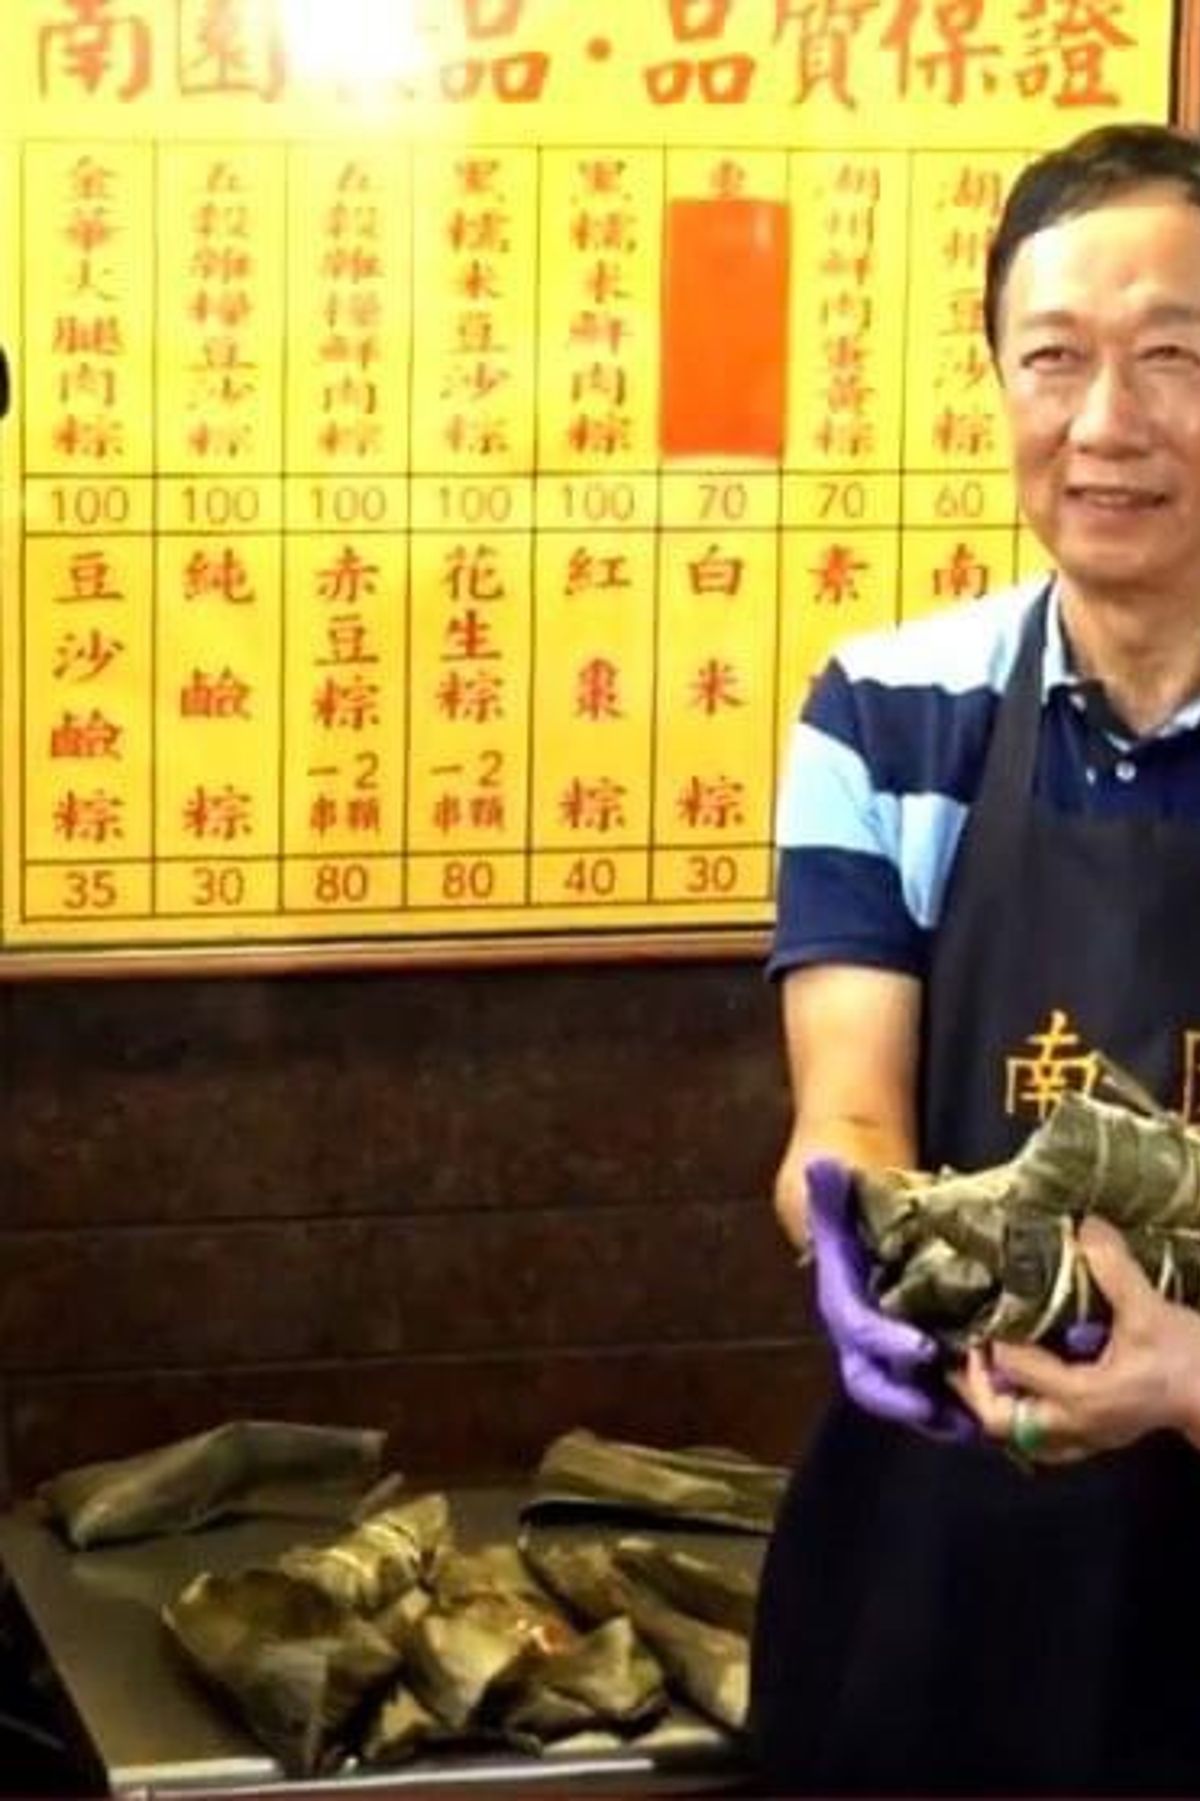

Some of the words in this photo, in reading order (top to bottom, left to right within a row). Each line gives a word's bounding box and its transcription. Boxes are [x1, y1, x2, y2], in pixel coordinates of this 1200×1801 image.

[51, 487, 129, 525] 100
[183, 486, 260, 524] 100
[309, 486, 387, 523] 100
[437, 485, 512, 522] 100
[560, 483, 635, 521] 100
[698, 484, 747, 521] 70
[816, 482, 866, 520] 70
[933, 481, 985, 519] 60
[677, 544, 746, 829] 白米粽
[62, 869, 118, 909] 35
[192, 867, 246, 906] 30
[314, 864, 369, 902] 80
[441, 862, 496, 899] 80
[563, 859, 616, 896] 40
[685, 856, 738, 893] 30
